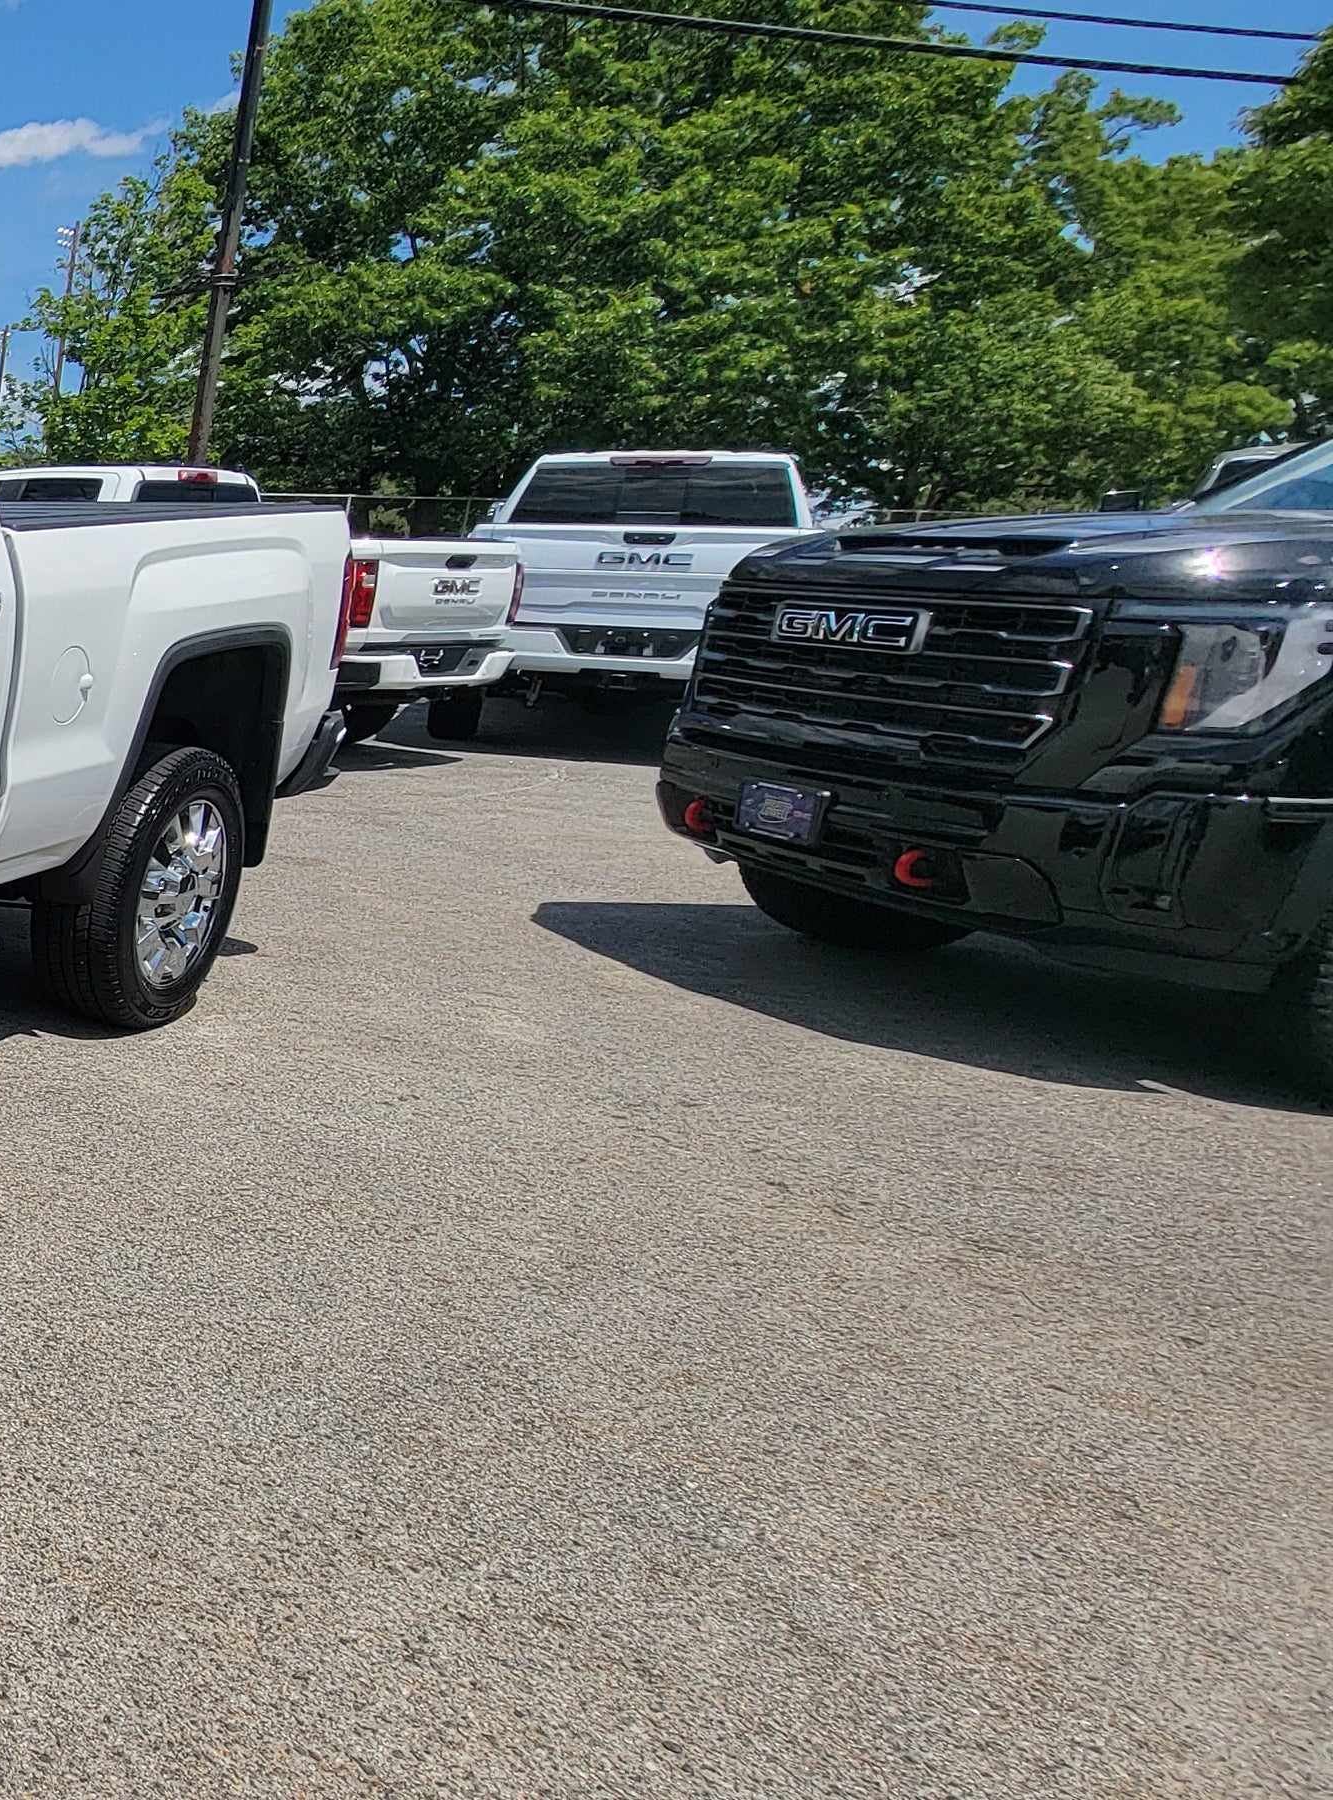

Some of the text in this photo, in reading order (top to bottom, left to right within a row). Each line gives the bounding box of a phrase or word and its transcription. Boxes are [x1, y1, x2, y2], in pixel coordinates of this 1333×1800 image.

[597, 551, 694, 566] GMC
[434, 578, 480, 595] GMC
[776, 608, 914, 647] GMC
